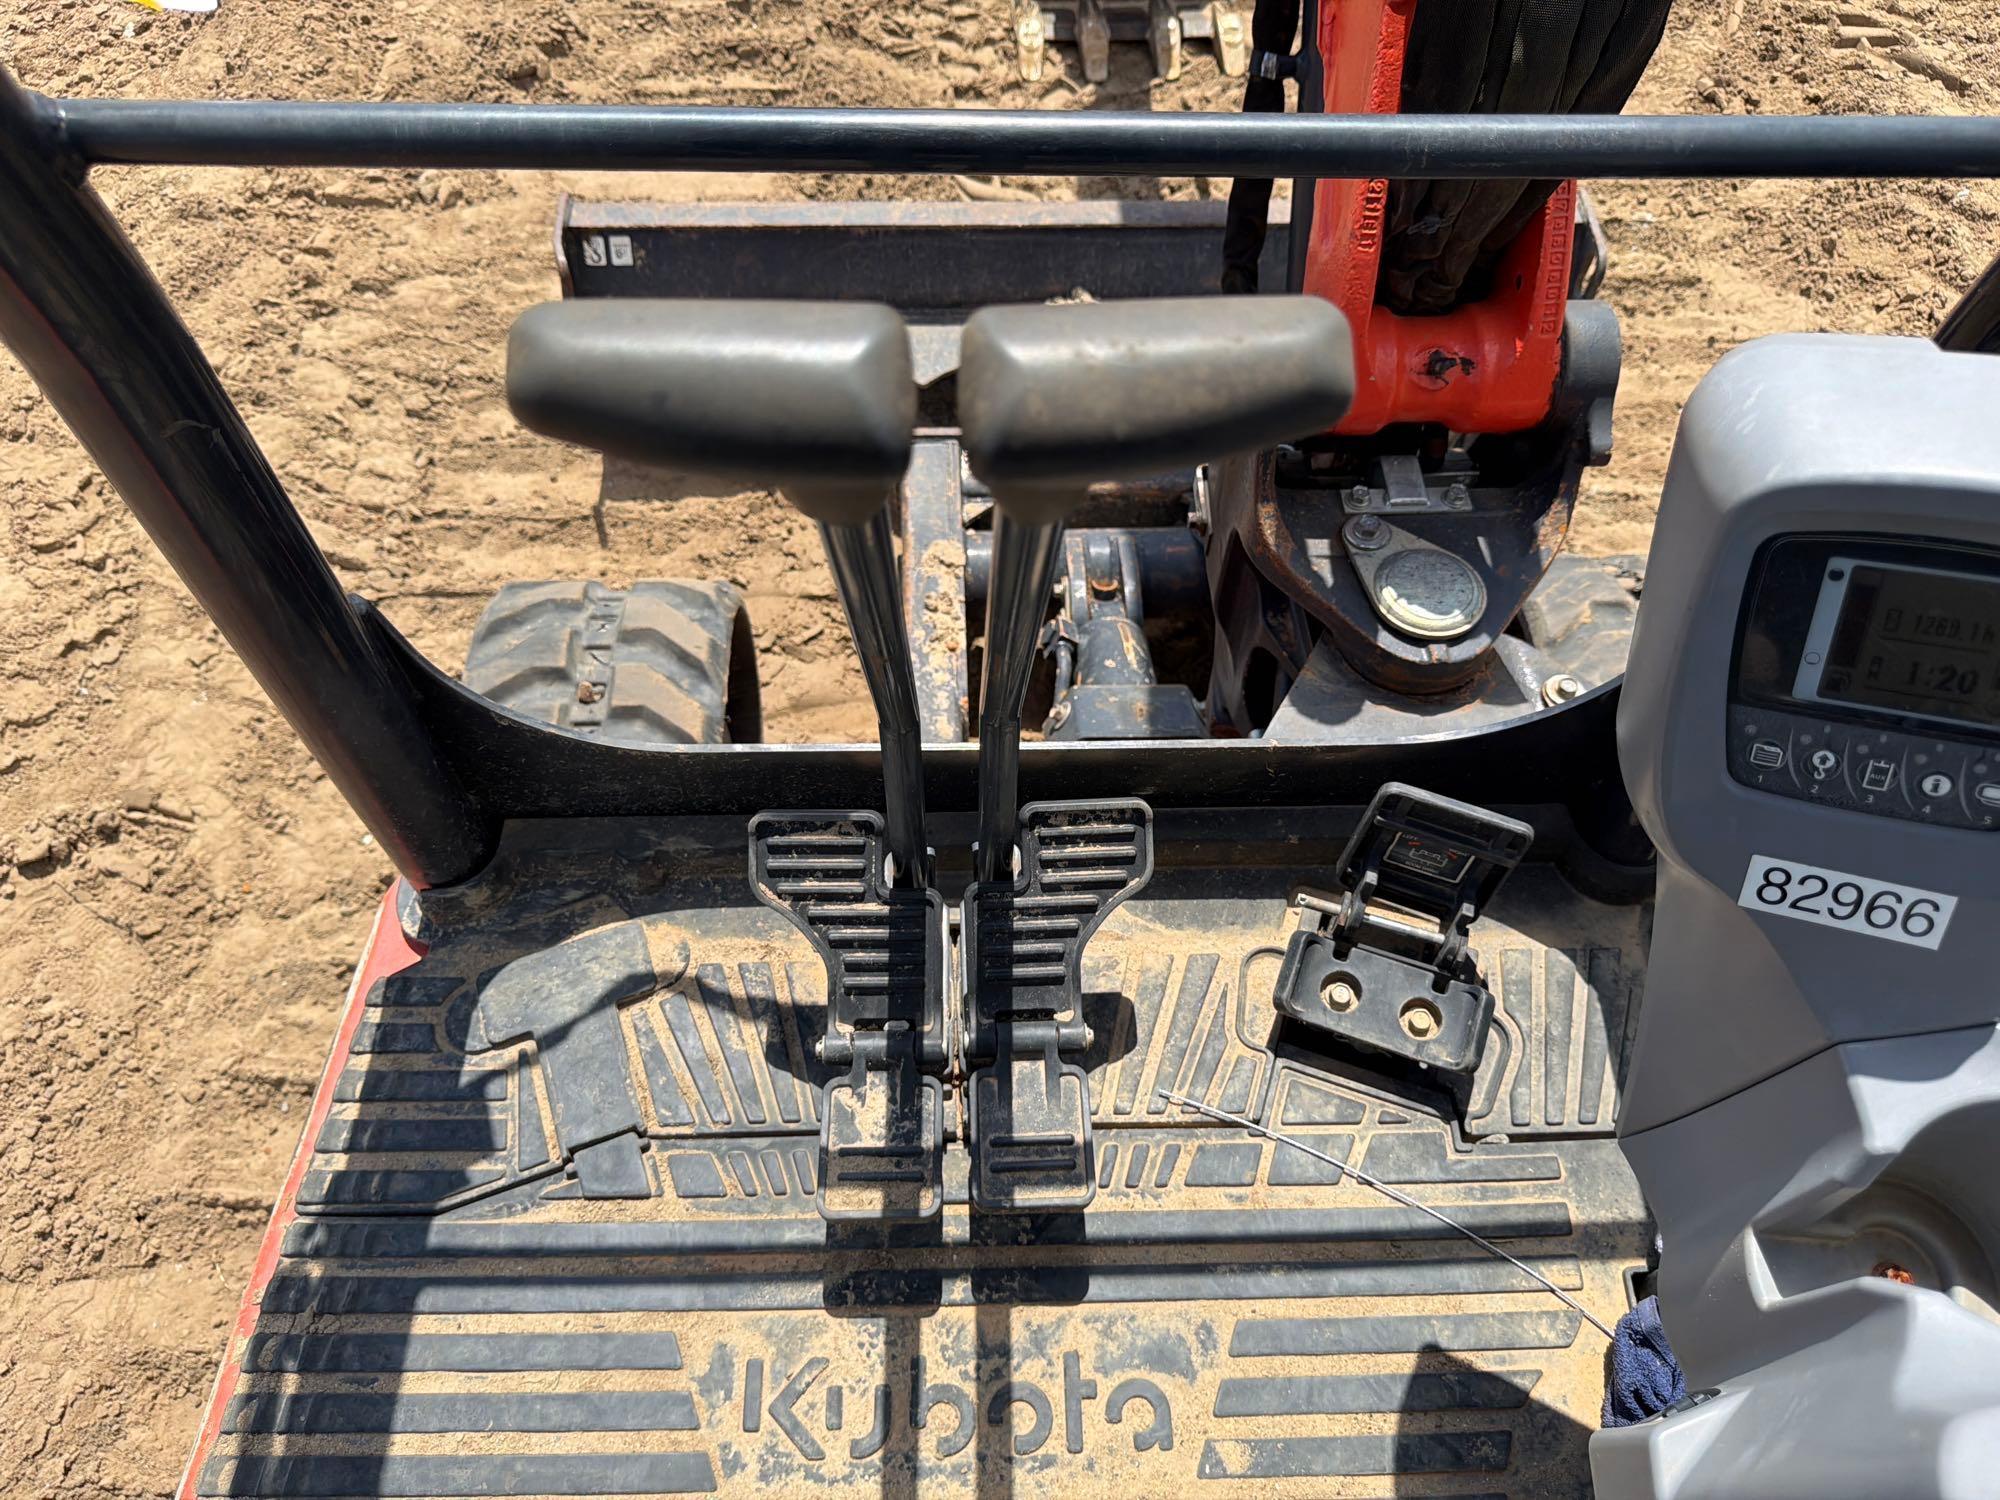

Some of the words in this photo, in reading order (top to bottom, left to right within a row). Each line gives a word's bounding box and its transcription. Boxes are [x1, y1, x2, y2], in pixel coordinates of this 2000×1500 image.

[1869, 772, 1887, 782] AUX
[1756, 866, 1941, 938] 82966
[742, 1350, 1174, 1461] Kubota
